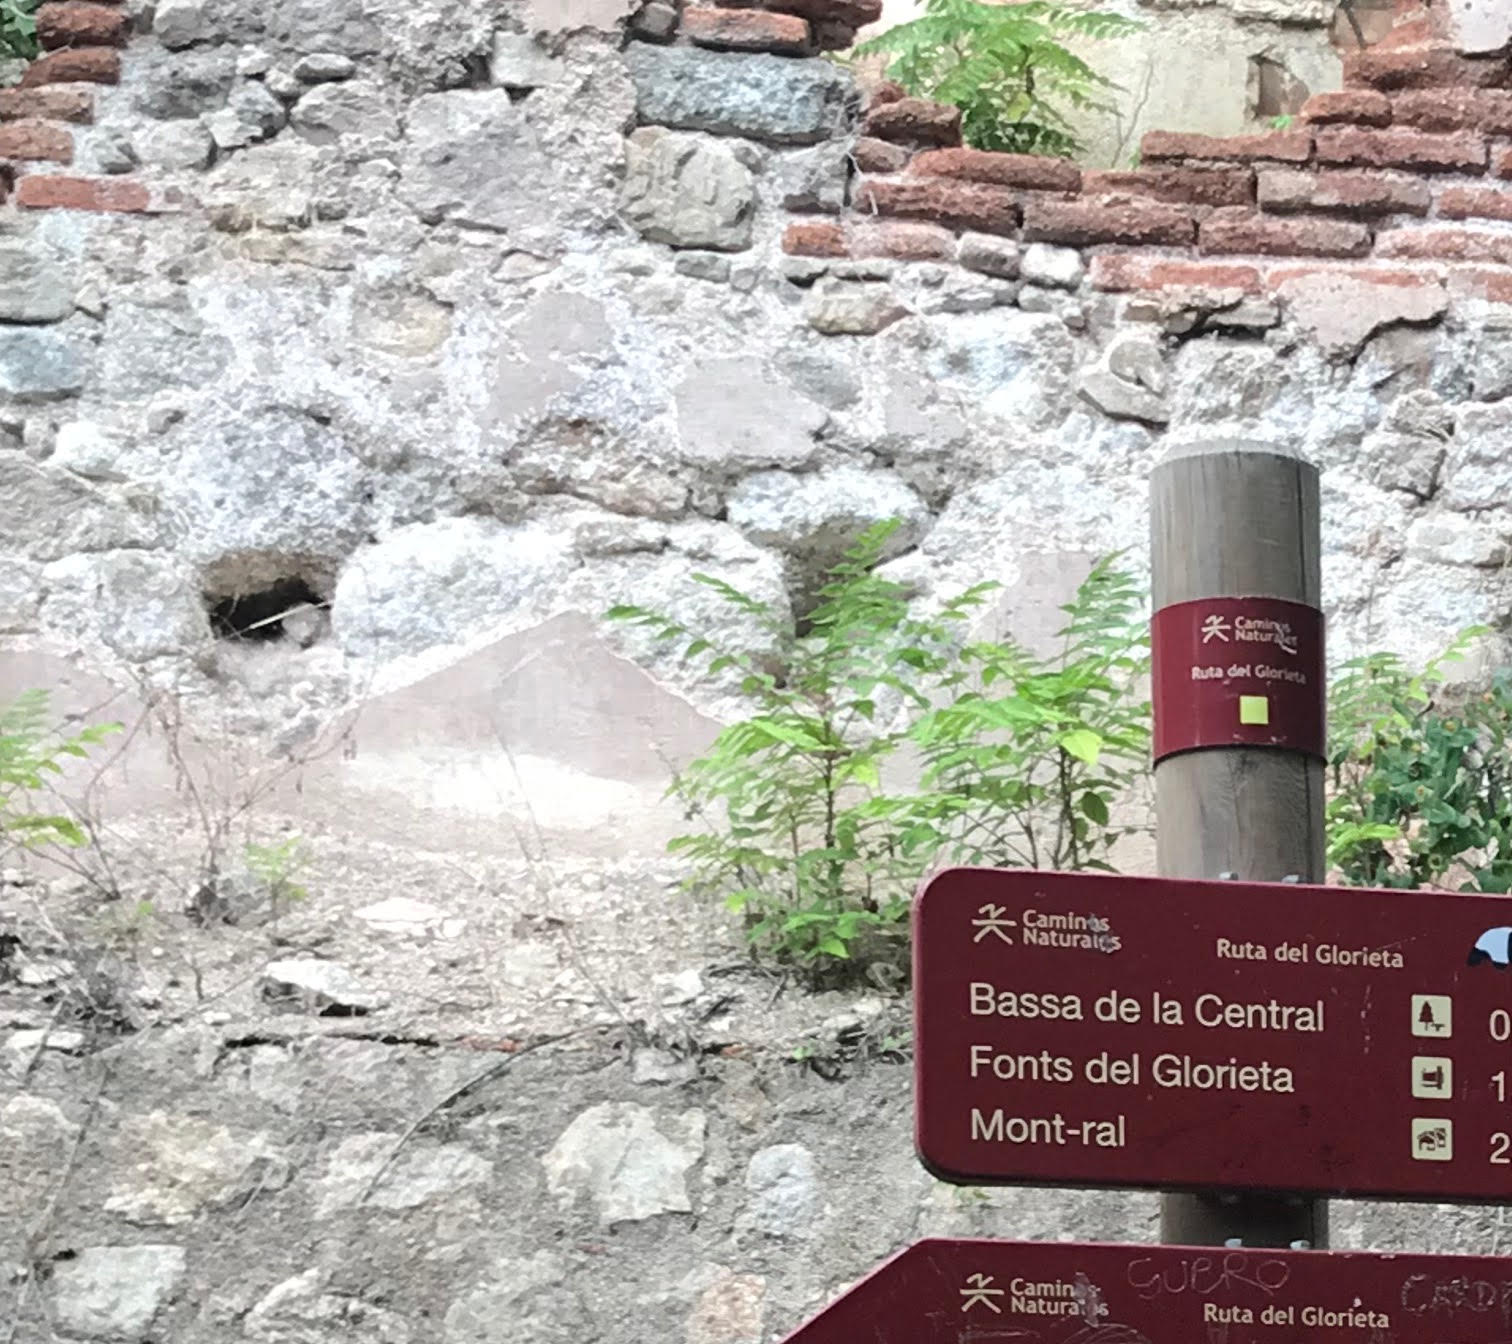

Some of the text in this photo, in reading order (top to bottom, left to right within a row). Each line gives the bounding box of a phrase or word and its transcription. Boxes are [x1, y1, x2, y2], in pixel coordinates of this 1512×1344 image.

[1191, 664, 1307, 684] Ruta del Glorieta
[1217, 938, 1404, 968] Ruta del Glorieta
[969, 982, 1325, 1032] Bassa de la Central
[970, 1045, 1295, 1093] Fonts del Glorieta
[970, 1108, 1126, 1147] Mont-ral
[1203, 1303, 1390, 1329] Ruta del Glorieta
